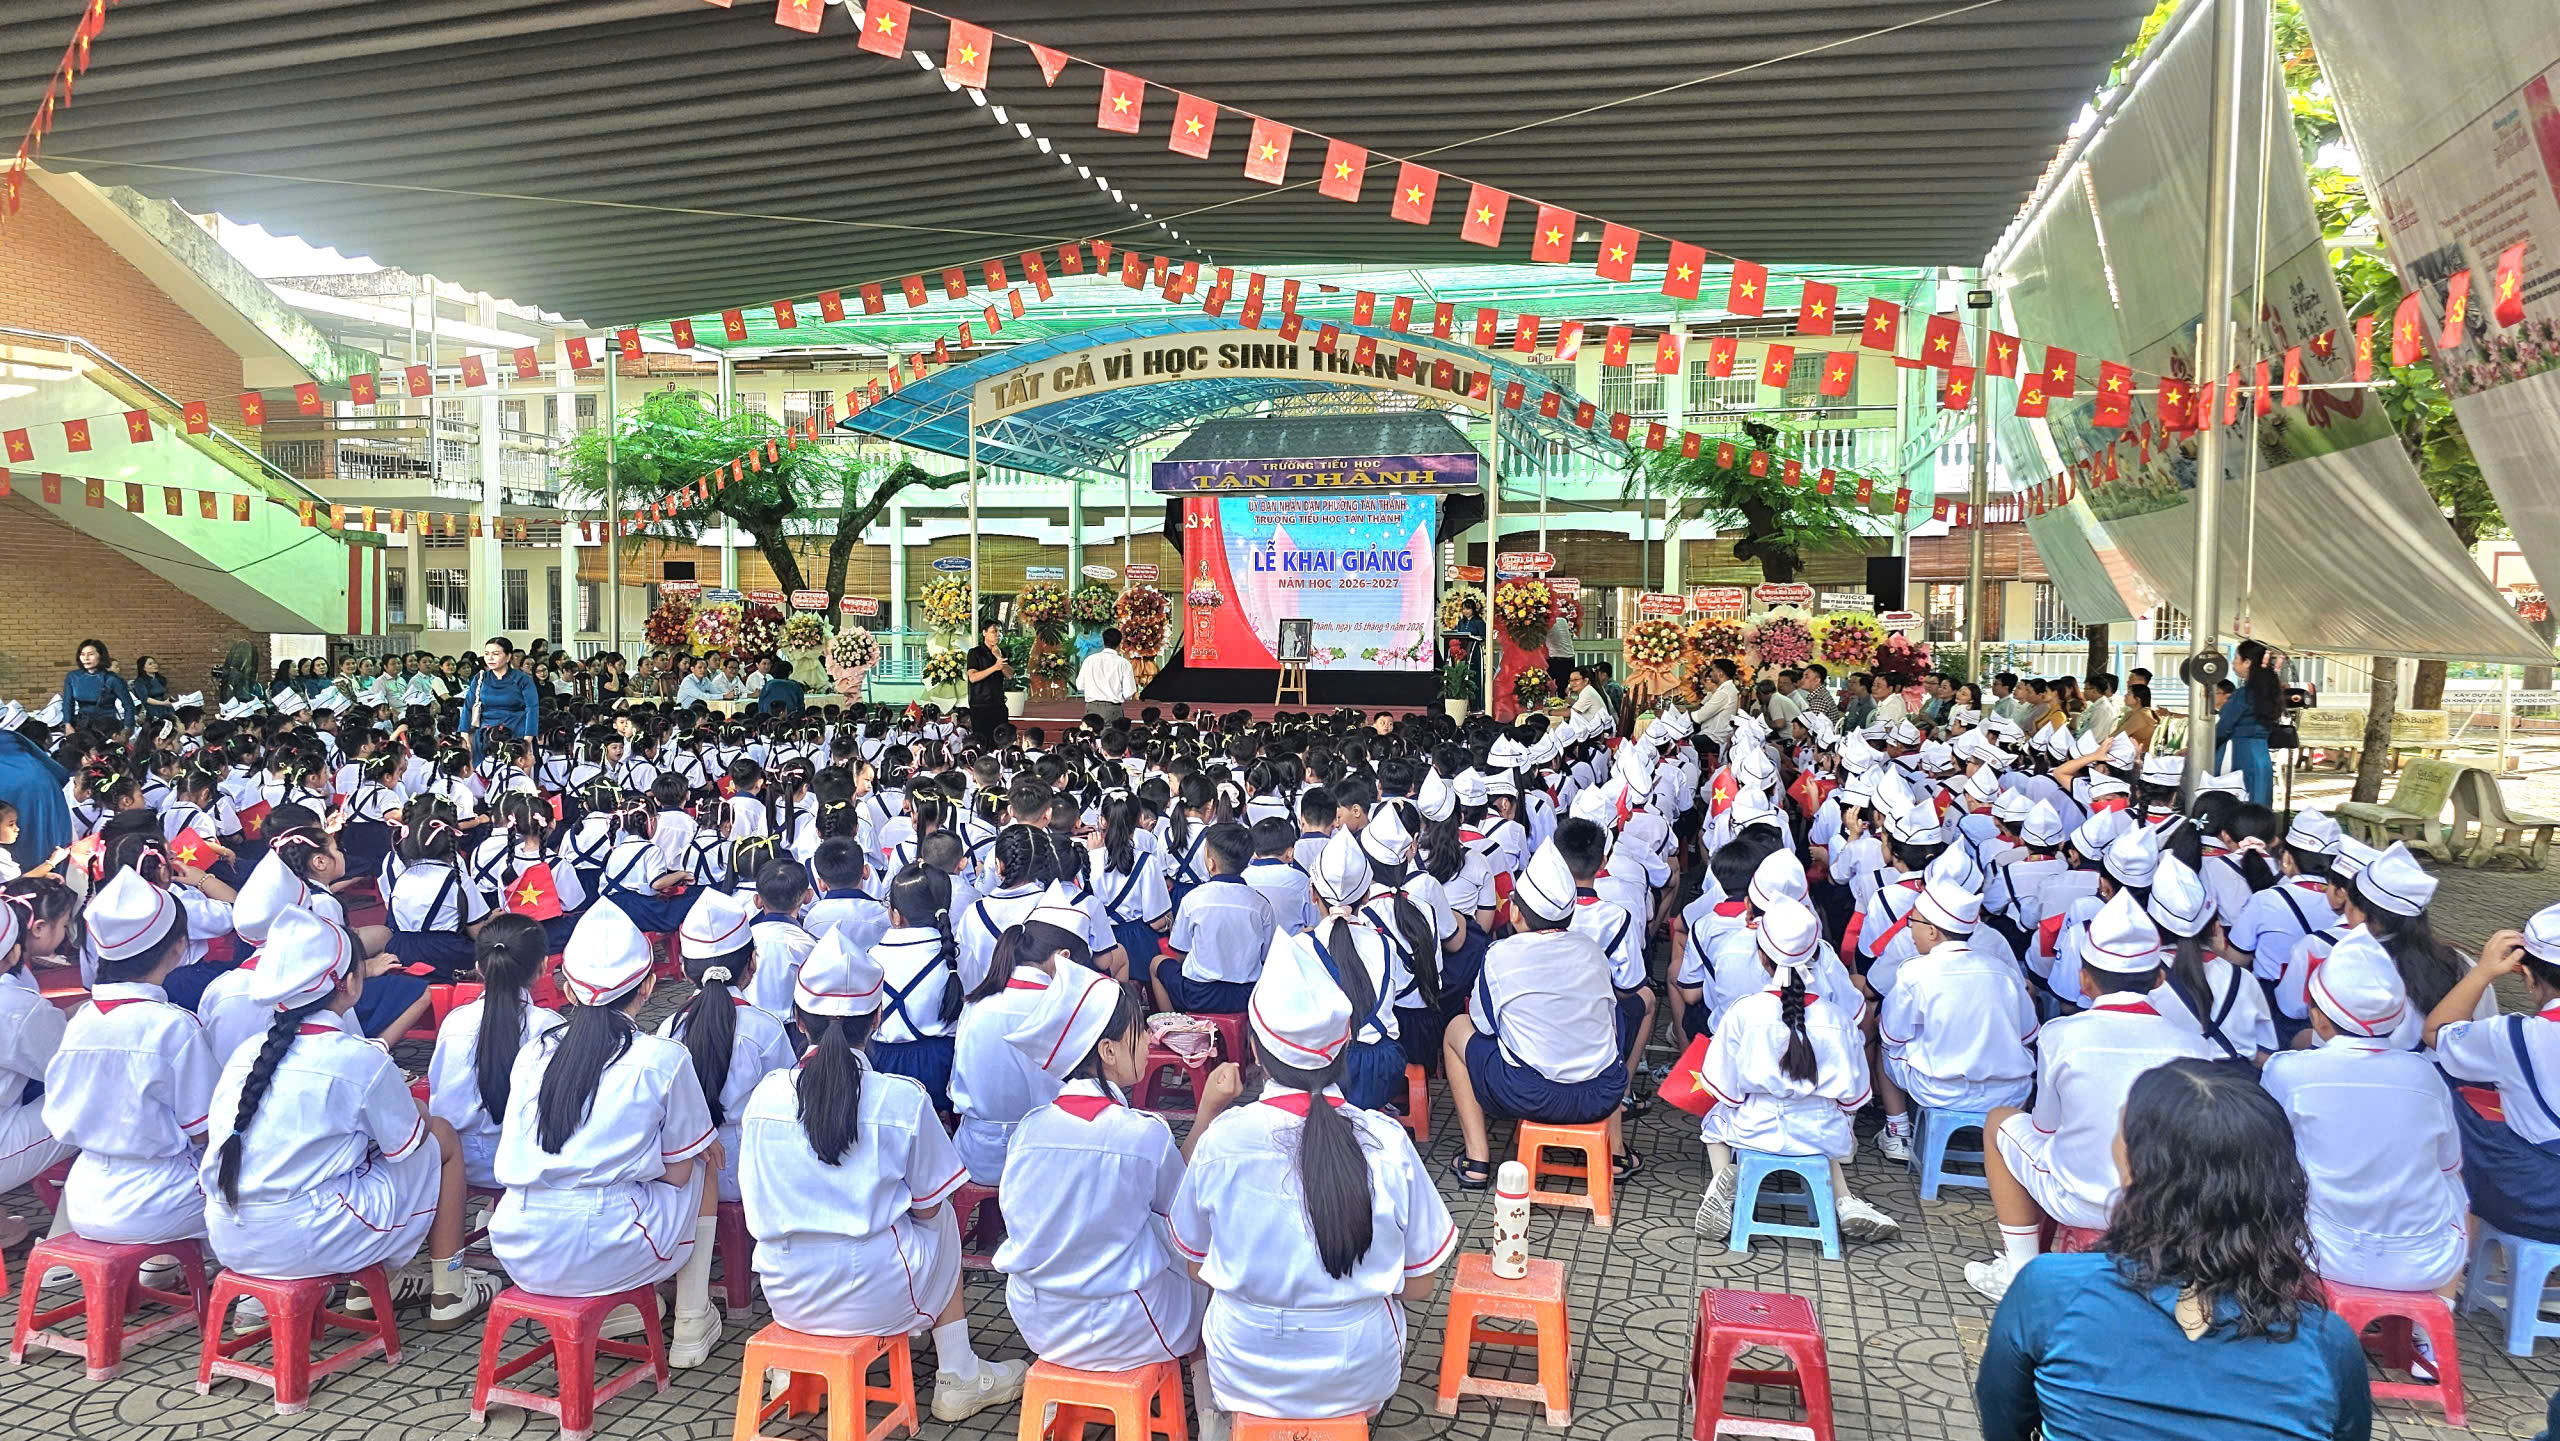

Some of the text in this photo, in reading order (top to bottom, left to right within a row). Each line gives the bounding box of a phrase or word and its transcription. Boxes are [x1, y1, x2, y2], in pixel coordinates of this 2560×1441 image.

[1535, 354, 1545, 364] 19
[990, 366, 1044, 410] TẤT
[1053, 352, 1098, 393] CẢ
[1103, 347, 1134, 382] VÌ
[1144, 345, 1208, 379] HỌC
[1218, 343, 1298, 369] SINH
[1413, 358, 1474, 397] YU
[668, 383, 675, 391] 17
[1262, 459, 1381, 471] TRƯỜNG TIỂU HỌC
[1192, 469, 1437, 489] TÂN THÀNH
[1261, 500, 1277, 512] BAN
[1279, 499, 1301, 512] NHÂN
[1303, 499, 1320, 512] DÂN
[1322, 498, 1357, 512] PHƯỜNG
[1359, 498, 1376, 511] TÂN
[1378, 497, 1407, 511] THÀNH
[1255, 513, 1402, 525] TRƯỜNG TIỂU HỌC TÂN THÀNH
[1254, 540, 1413, 572] LỄ KHAI GIẢNG
[1278, 577, 1399, 591] NĂM HỌC 2026-2027
[1336, 623, 1352, 633] ngày
[1353, 623, 1363, 631] 05
[1364, 622, 1383, 633] tháng
[1384, 622, 1390, 631] 9
[1390, 623, 1406, 632] năm
[1406, 621, 1424, 631] 2026
[2309, 713, 2349, 722] SeABank
[2392, 715, 2434, 724] SeABank
